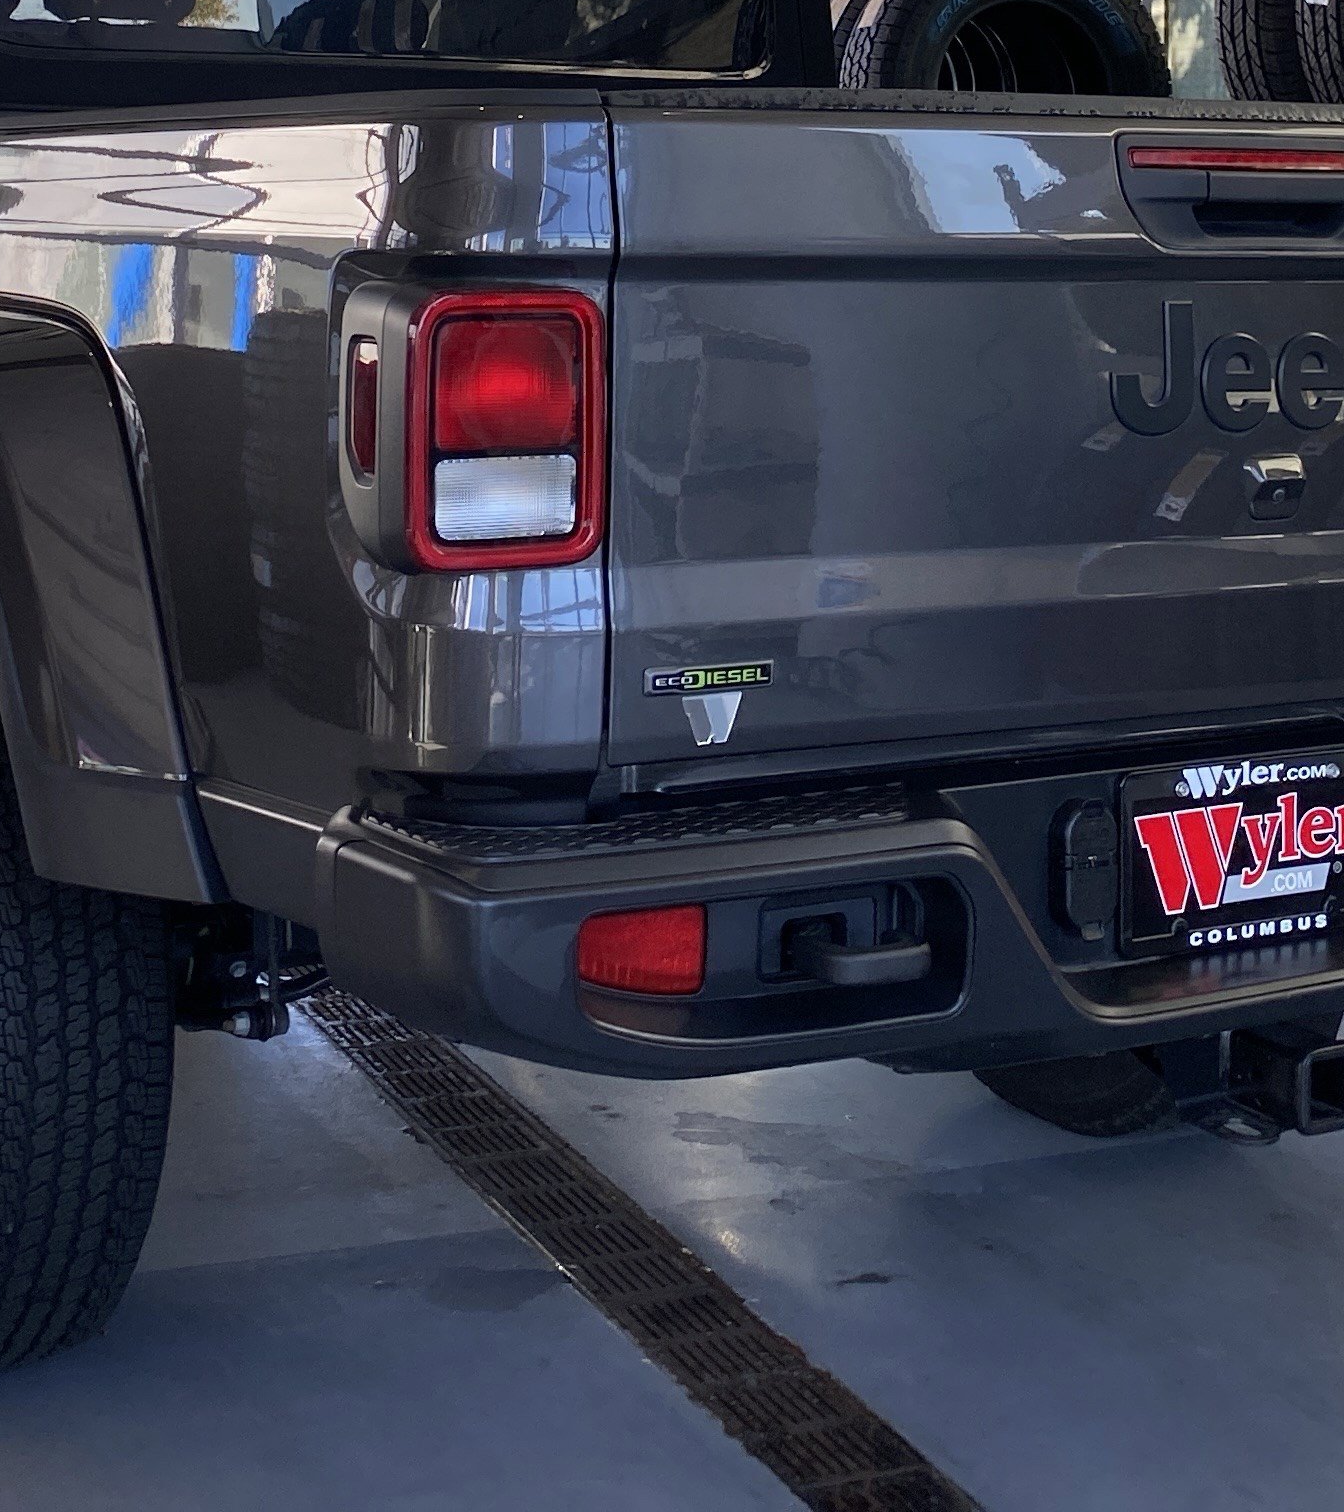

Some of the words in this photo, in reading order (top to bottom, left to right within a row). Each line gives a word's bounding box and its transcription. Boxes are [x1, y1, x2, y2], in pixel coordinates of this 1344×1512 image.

[655, 667, 770, 690] ECODIESEL
[1270, 870, 1314, 893] .COM
[1189, 913, 1328, 947] COLUMBUS
